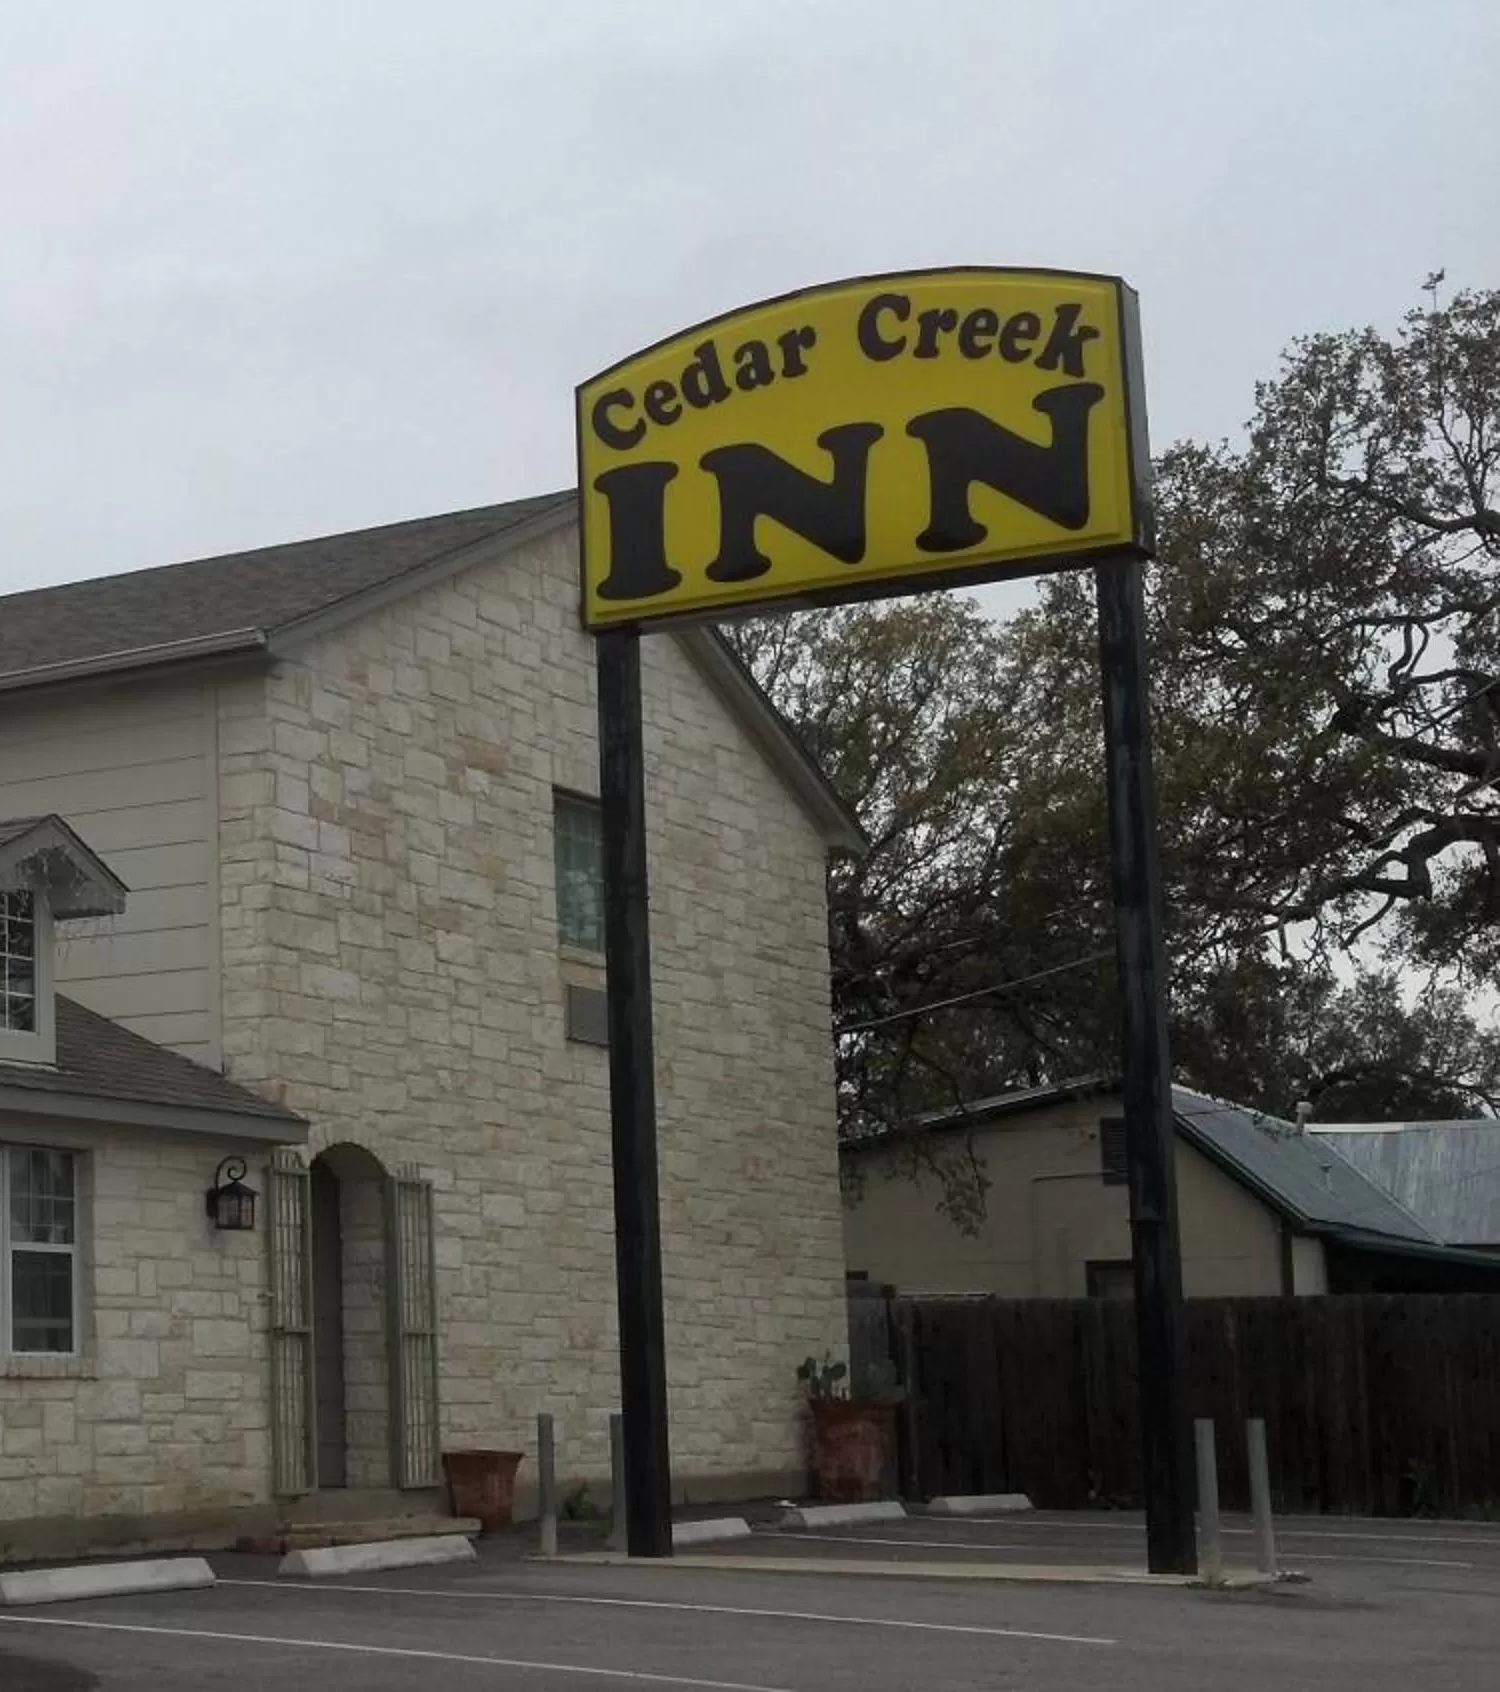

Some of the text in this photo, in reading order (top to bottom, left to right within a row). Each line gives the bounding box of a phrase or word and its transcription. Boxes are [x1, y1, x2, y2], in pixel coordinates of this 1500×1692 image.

[591, 293, 1100, 451] Cedar Creek
[594, 383, 1106, 600] INN
